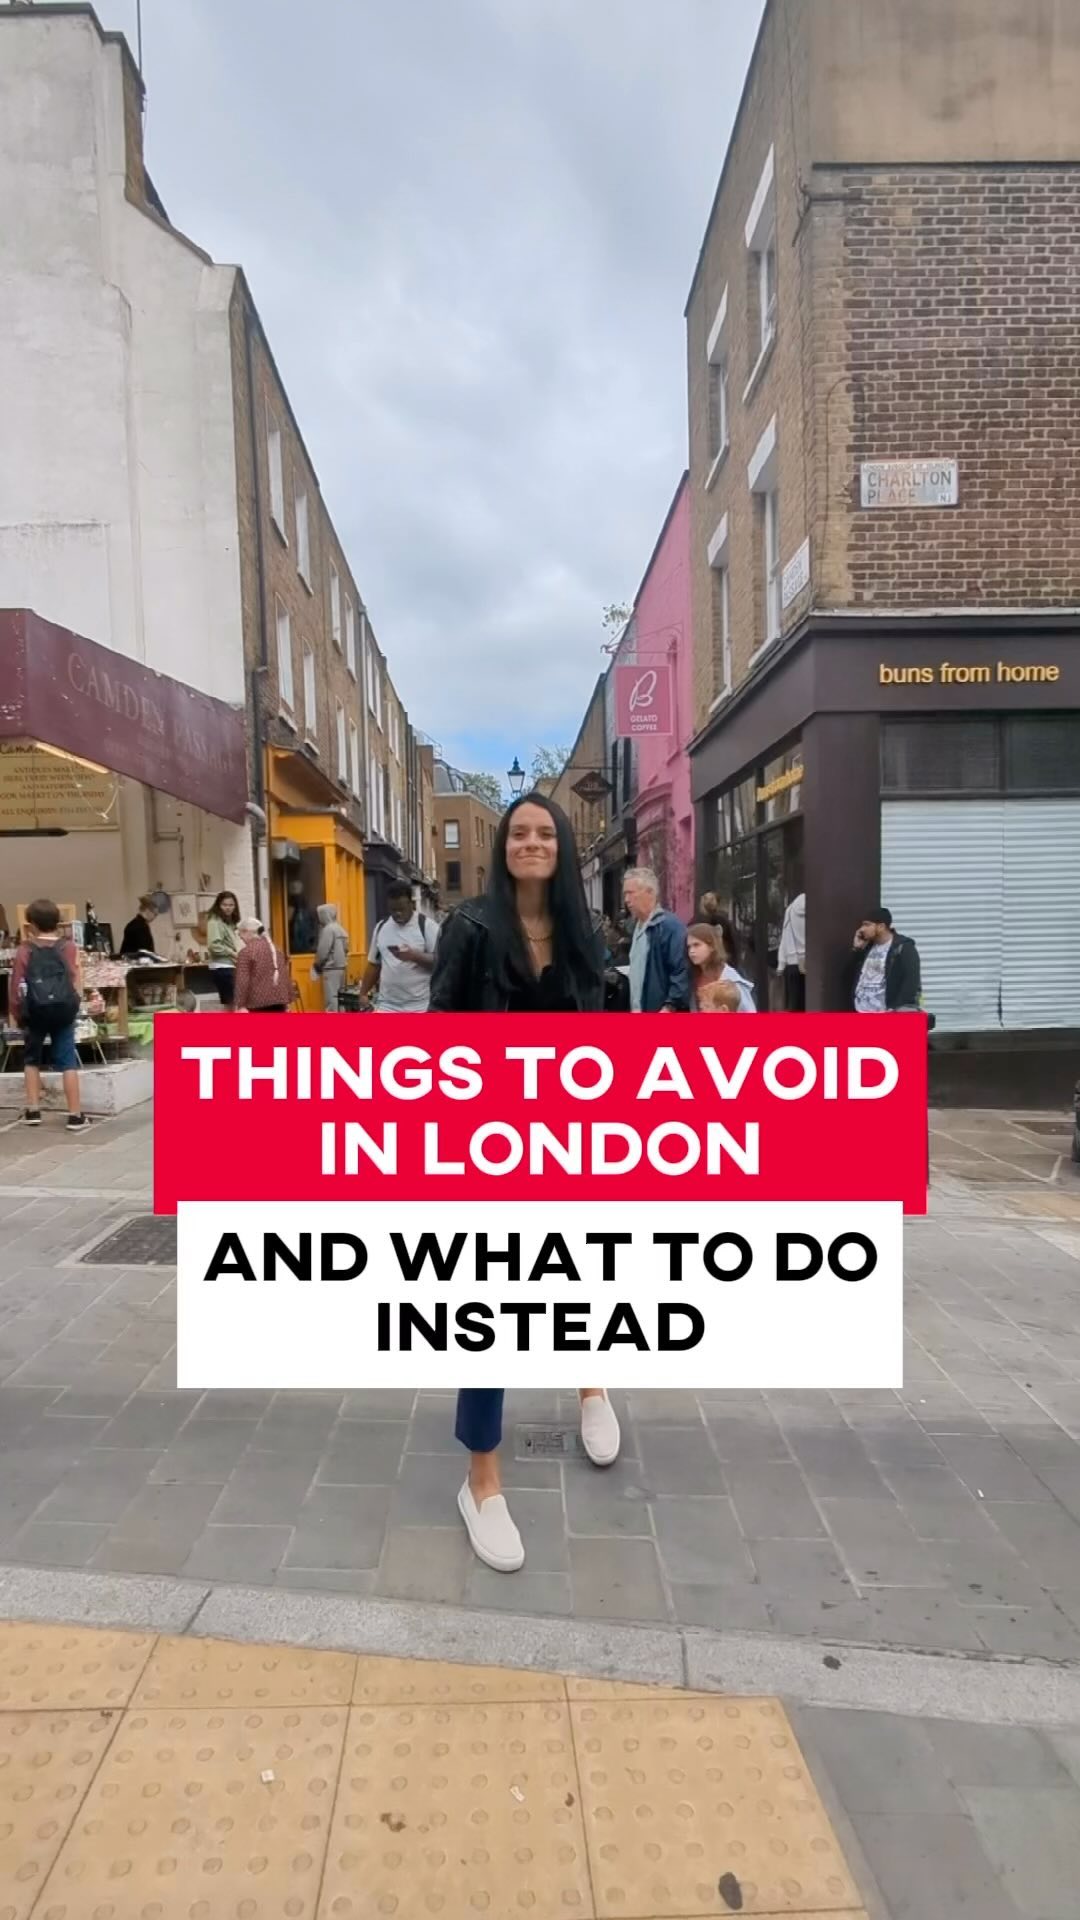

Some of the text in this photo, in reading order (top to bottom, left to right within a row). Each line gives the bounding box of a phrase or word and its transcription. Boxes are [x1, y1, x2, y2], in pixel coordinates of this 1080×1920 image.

[867, 470, 952, 488] CHARLTON
[867, 488, 916, 505] PLACE
[879, 661, 1060, 684] buns from home
[630, 714, 658, 723] GELATO
